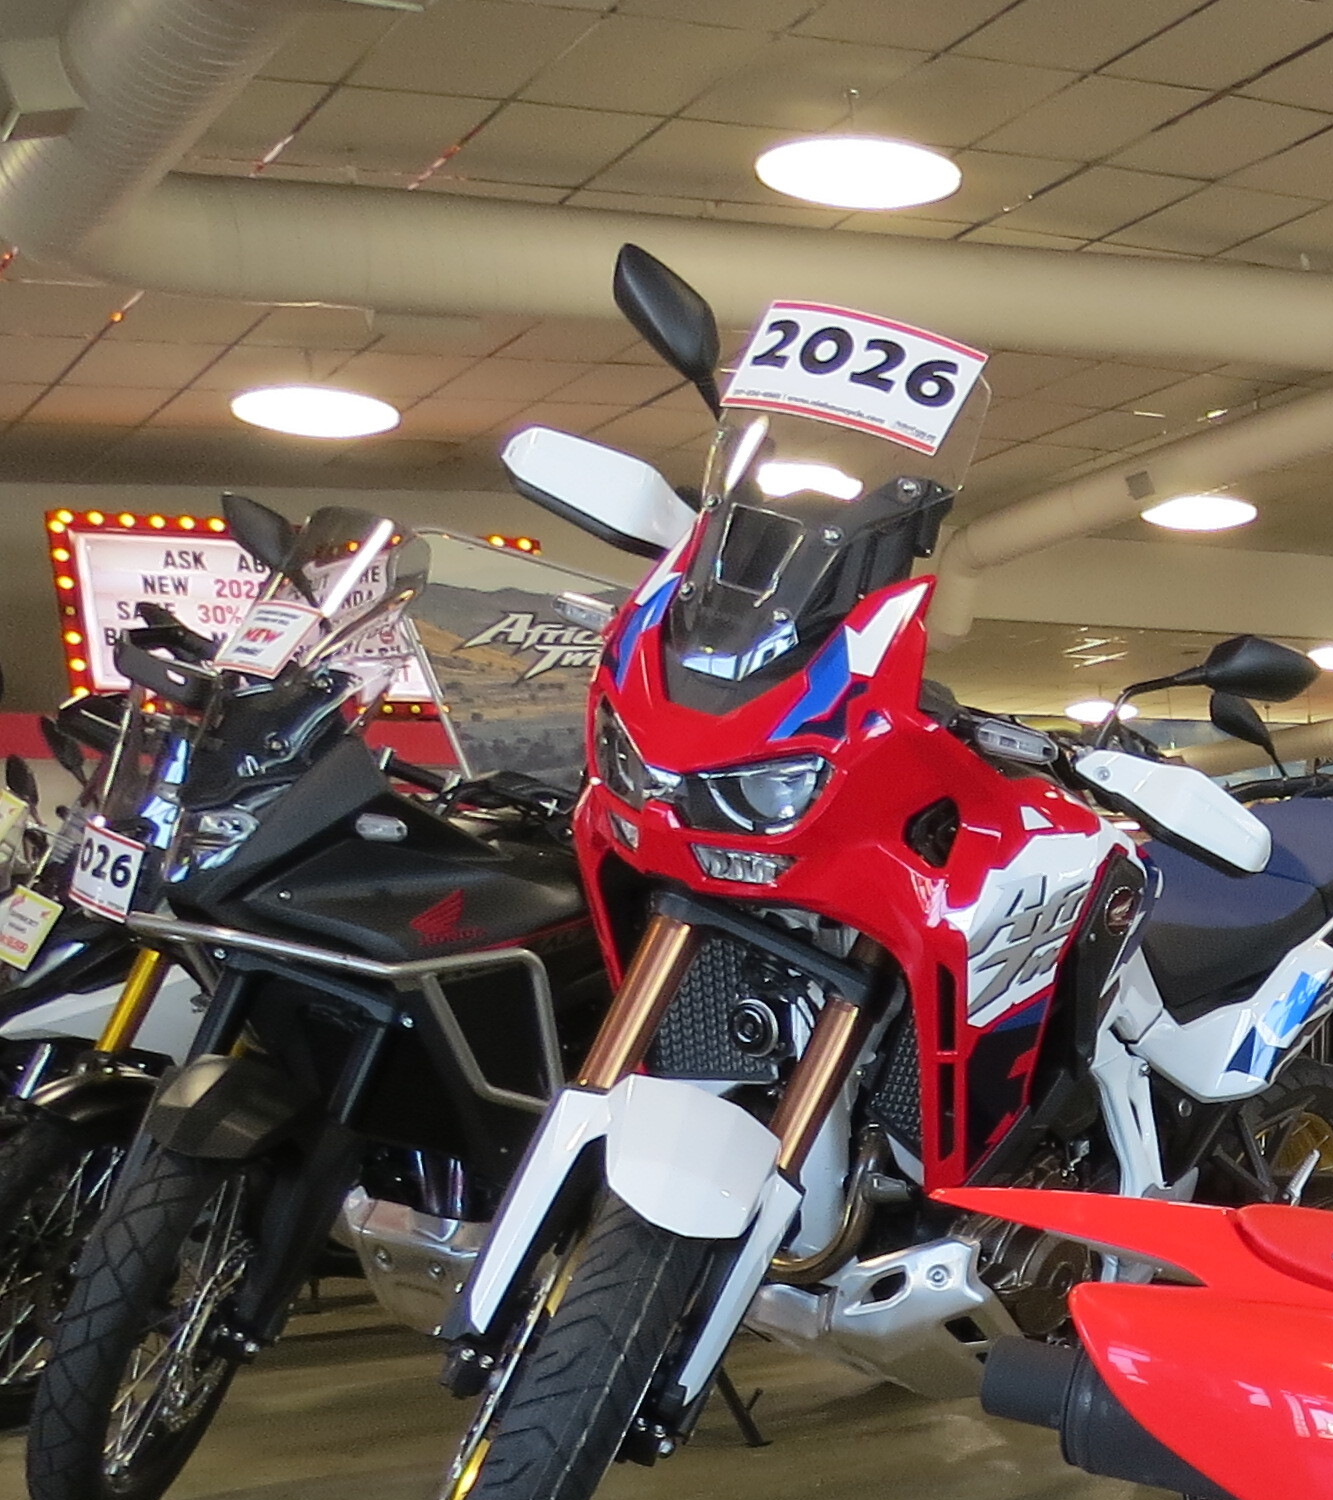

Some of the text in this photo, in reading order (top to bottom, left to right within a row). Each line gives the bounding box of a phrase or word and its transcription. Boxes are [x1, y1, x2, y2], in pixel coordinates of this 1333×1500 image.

[750, 319, 959, 408] 2026
[163, 550, 208, 571] ASK
[141, 574, 190, 597] NEW
[213, 578, 265, 600] 202
[197, 603, 244, 625] 30%
[80, 837, 133, 889] 026
